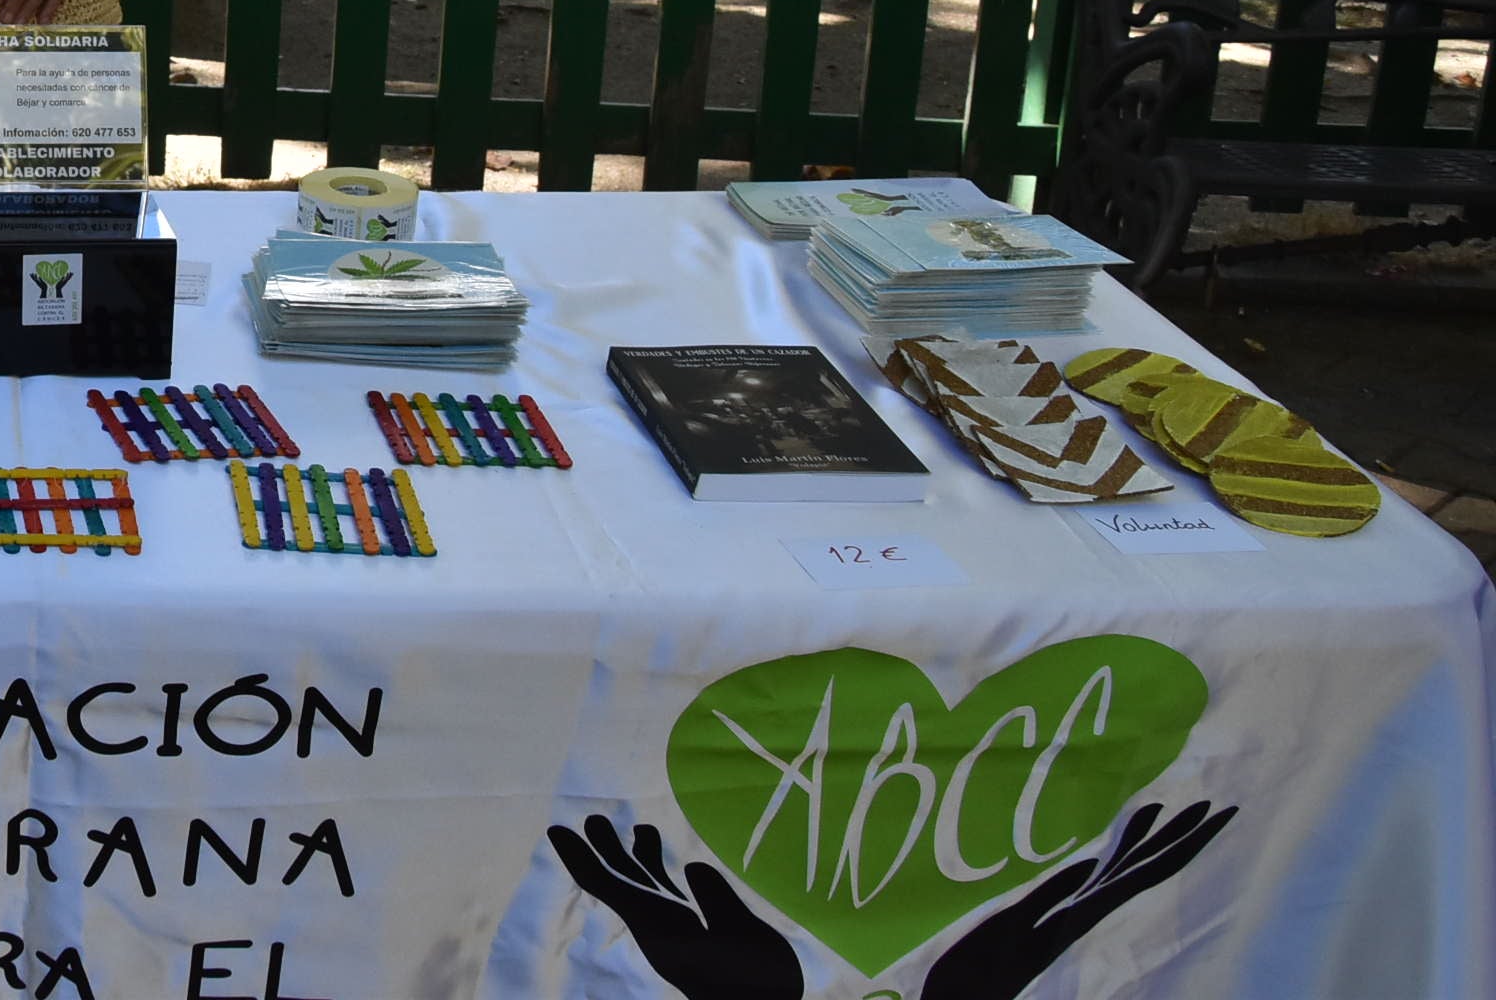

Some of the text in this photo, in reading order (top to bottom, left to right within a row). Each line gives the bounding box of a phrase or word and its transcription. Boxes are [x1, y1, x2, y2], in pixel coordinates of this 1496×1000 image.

[24, 35, 109, 48] SOLIDARIA
[15, 68, 37, 77] Para
[39, 68, 47, 77] la
[78, 68, 89, 77] de
[91, 69, 131, 79] personas
[16, 83, 68, 92] necesitadas
[70, 84, 86, 92] con
[41, 99, 47, 108] y
[72, 127, 92, 138] 620
[94, 127, 114, 137] 477
[116, 127, 136, 137] 653
[742, 456, 772, 464] Luis
[824, 454, 869, 462] Flores
[1097, 512, 1216, 533] Voluntad
[827, 545, 907, 564] 12 €
[711, 665, 1112, 910] ABCC
[186, 940, 332, 1000] EL
